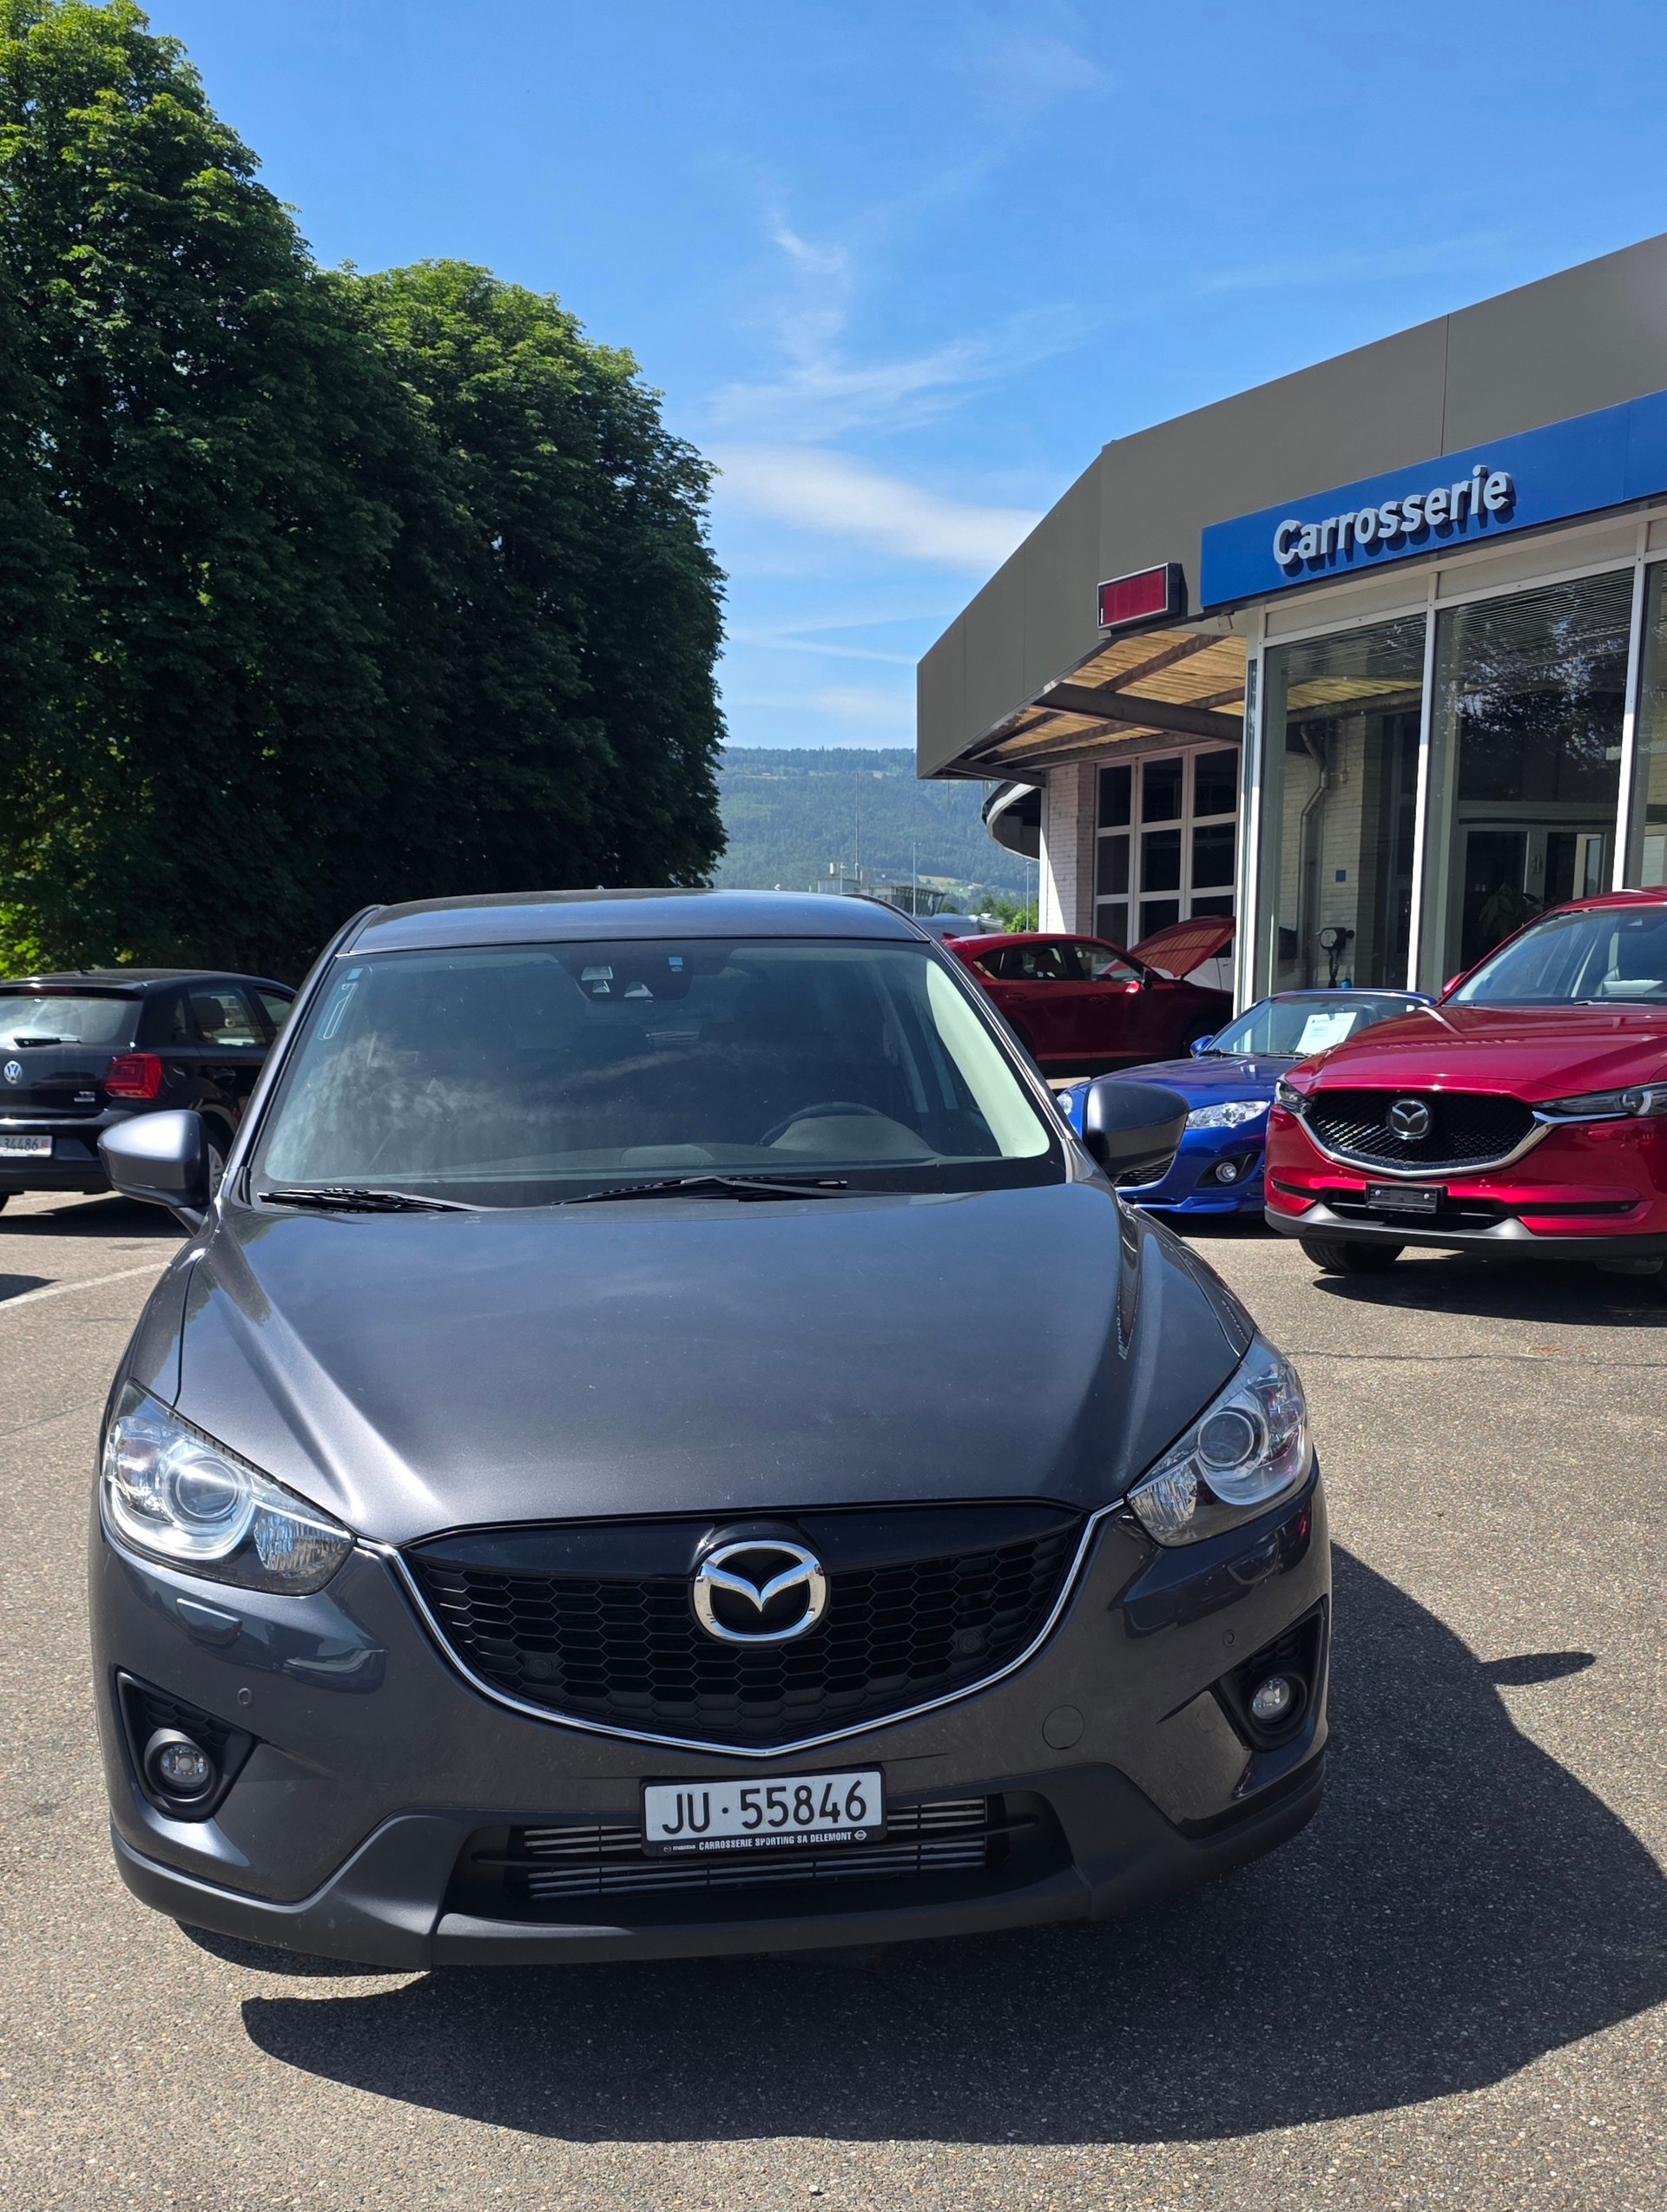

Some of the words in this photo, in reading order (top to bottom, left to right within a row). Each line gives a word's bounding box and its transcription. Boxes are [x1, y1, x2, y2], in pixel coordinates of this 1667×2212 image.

[1273, 464, 1511, 565] Carrosserie
[3, 1137, 38, 1152] 34486
[698, 1838, 754, 1851] CARROSSERIE
[754, 1835, 794, 1847] SPORTING
[796, 1833, 808, 1844] SA
[810, 1831, 852, 1843] DELEMONT
